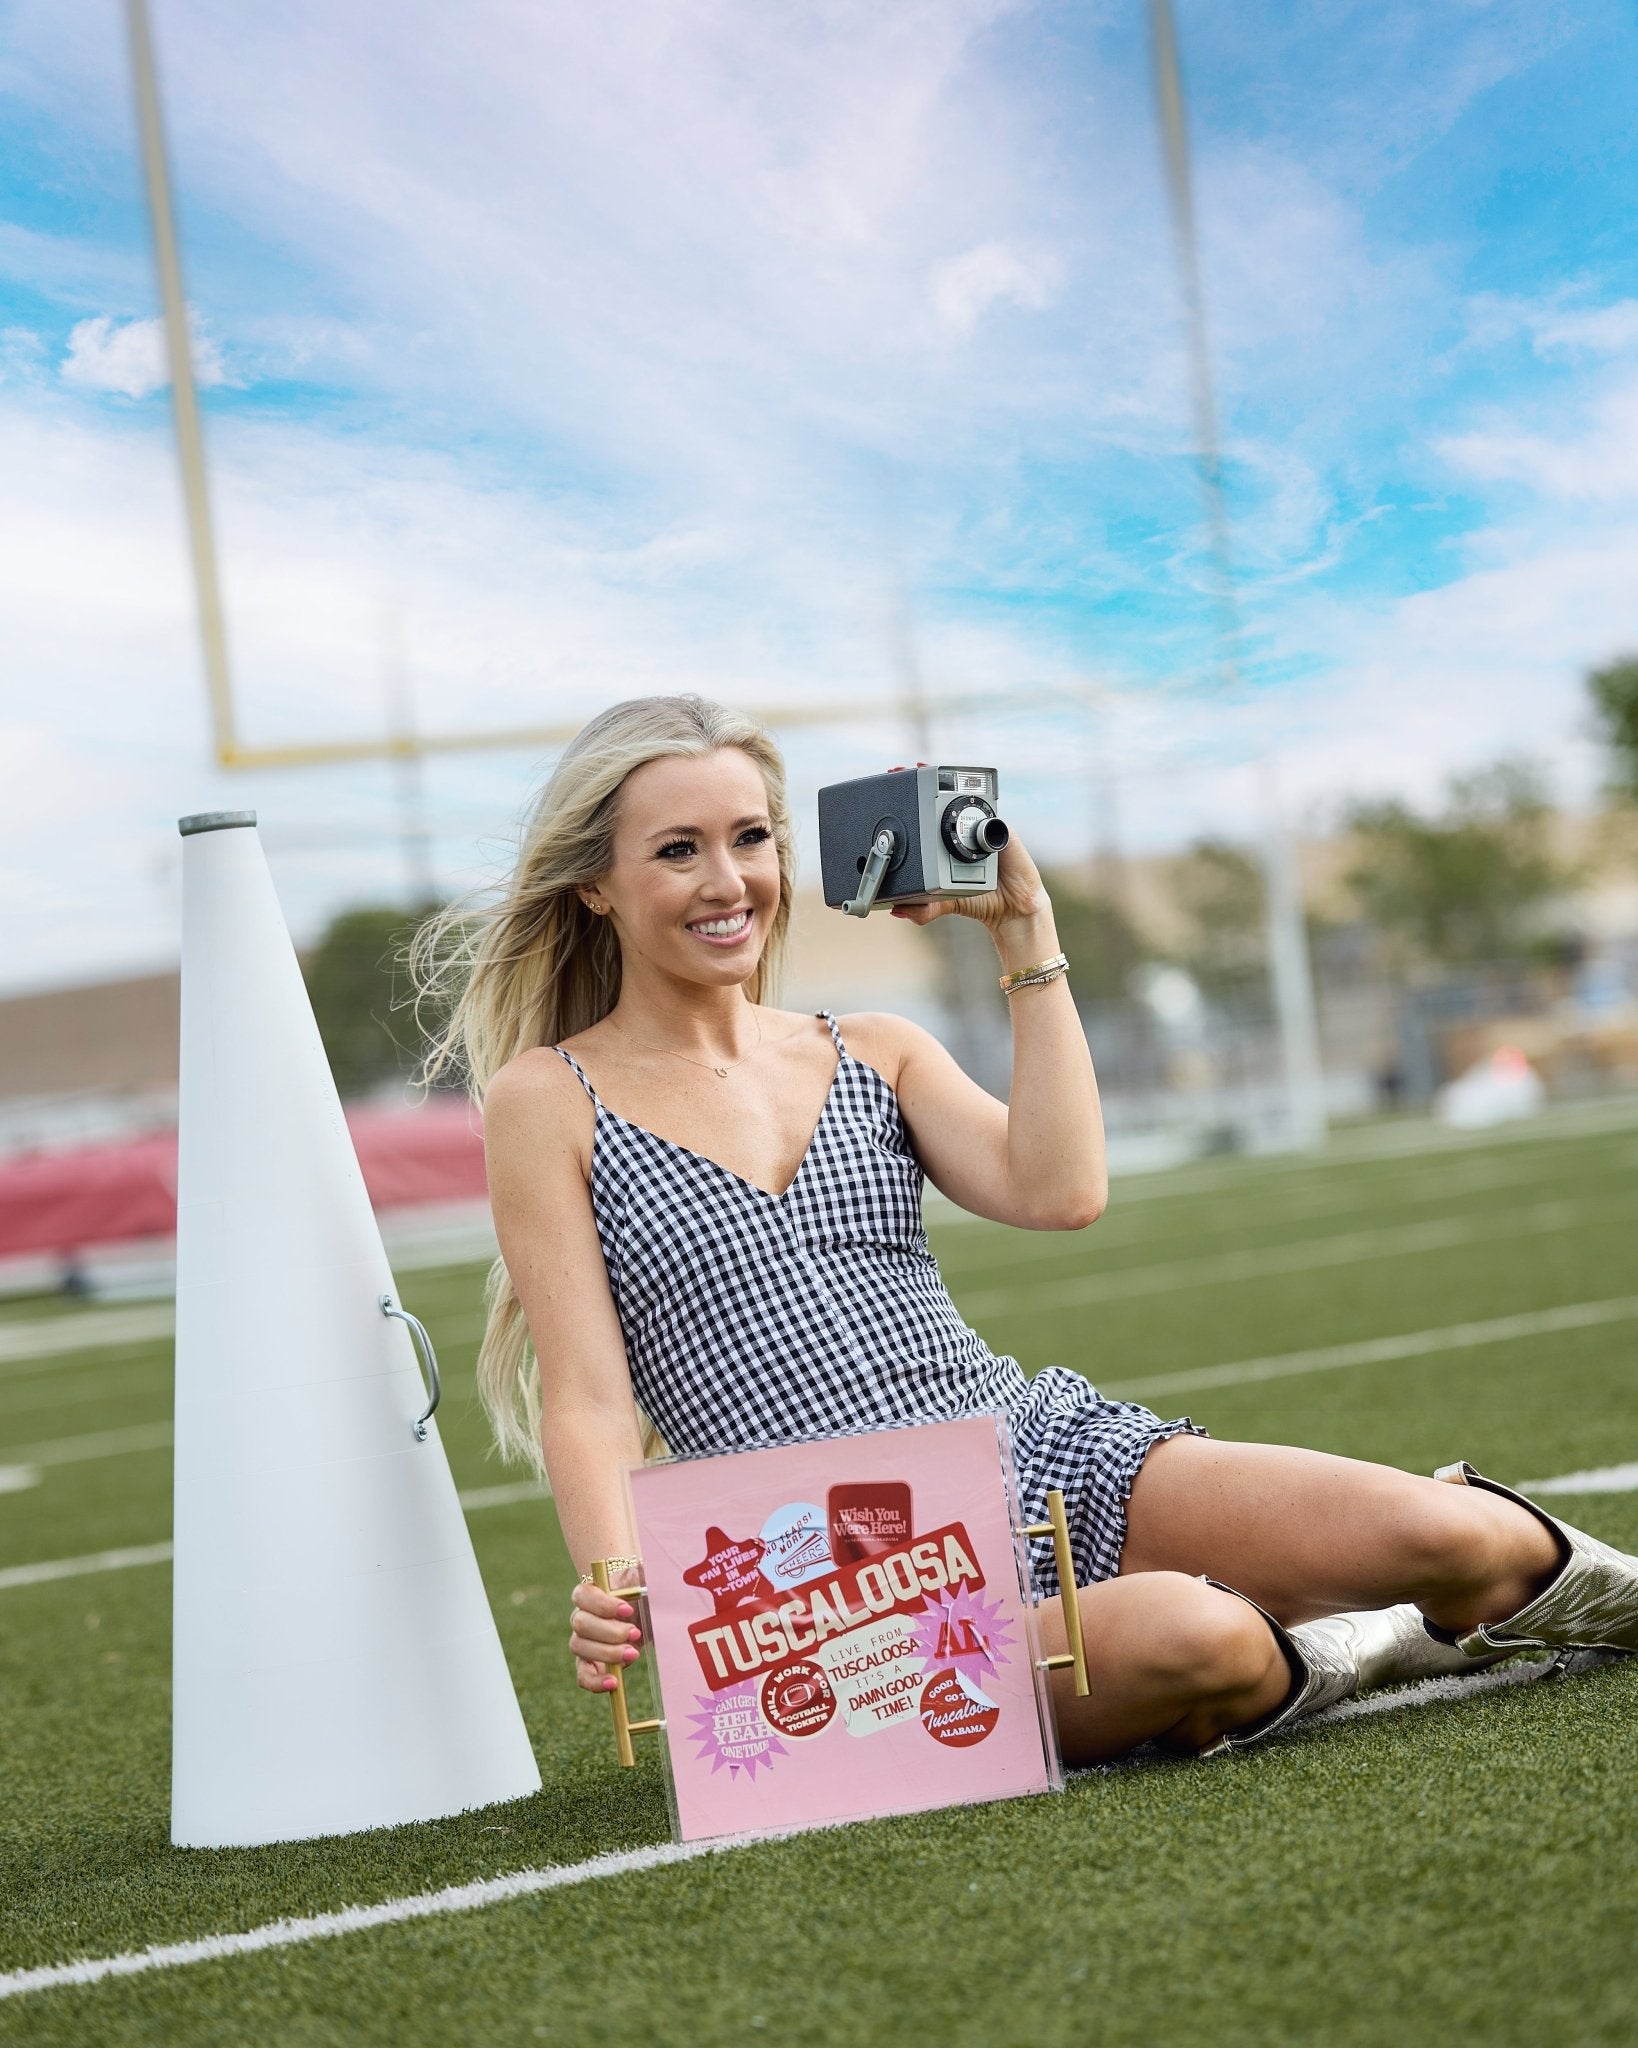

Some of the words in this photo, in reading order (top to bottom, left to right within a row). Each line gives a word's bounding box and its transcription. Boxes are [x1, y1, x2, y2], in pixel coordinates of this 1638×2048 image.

[839, 1507, 875, 1522] Wish
[874, 1507, 900, 1522] You
[833, 1522, 870, 1537] Were
[870, 1519, 907, 1535] Here!
[765, 1542, 777, 1557] NO
[780, 1530, 804, 1555] MORE
[699, 1565, 722, 1584] FAV
[722, 1548, 759, 1571] LIVES
[708, 1545, 740, 1567] YOUR
[784, 1544, 824, 1571] CHEERS
[713, 1568, 760, 1596] T-TOWN
[725, 1567, 741, 1582] IN
[695, 1534, 979, 1678] TUSCALOOSA
[830, 1643, 861, 1663] LIVE
[870, 1627, 903, 1647] FROM
[828, 1638, 920, 1682] TUSCALOOSA
[773, 1666, 811, 1684] WORK
[812, 1671, 831, 1699] FOR
[856, 1670, 885, 1689] IT'S
[894, 1664, 902, 1675] A
[848, 1686, 886, 1712] DAMN
[886, 1672, 923, 1696] GOOD
[928, 1679, 954, 1699] GOOD
[944, 1693, 959, 1703] GO
[767, 1686, 781, 1721] WILL
[778, 1703, 830, 1725] FOOTBALL
[872, 1695, 914, 1720] TIME!
[786, 1712, 828, 1732] TICKETS
[940, 1724, 986, 1738] ALABAMA
[712, 1723, 775, 1746] YEAH
[743, 1740, 769, 1758] TIME
